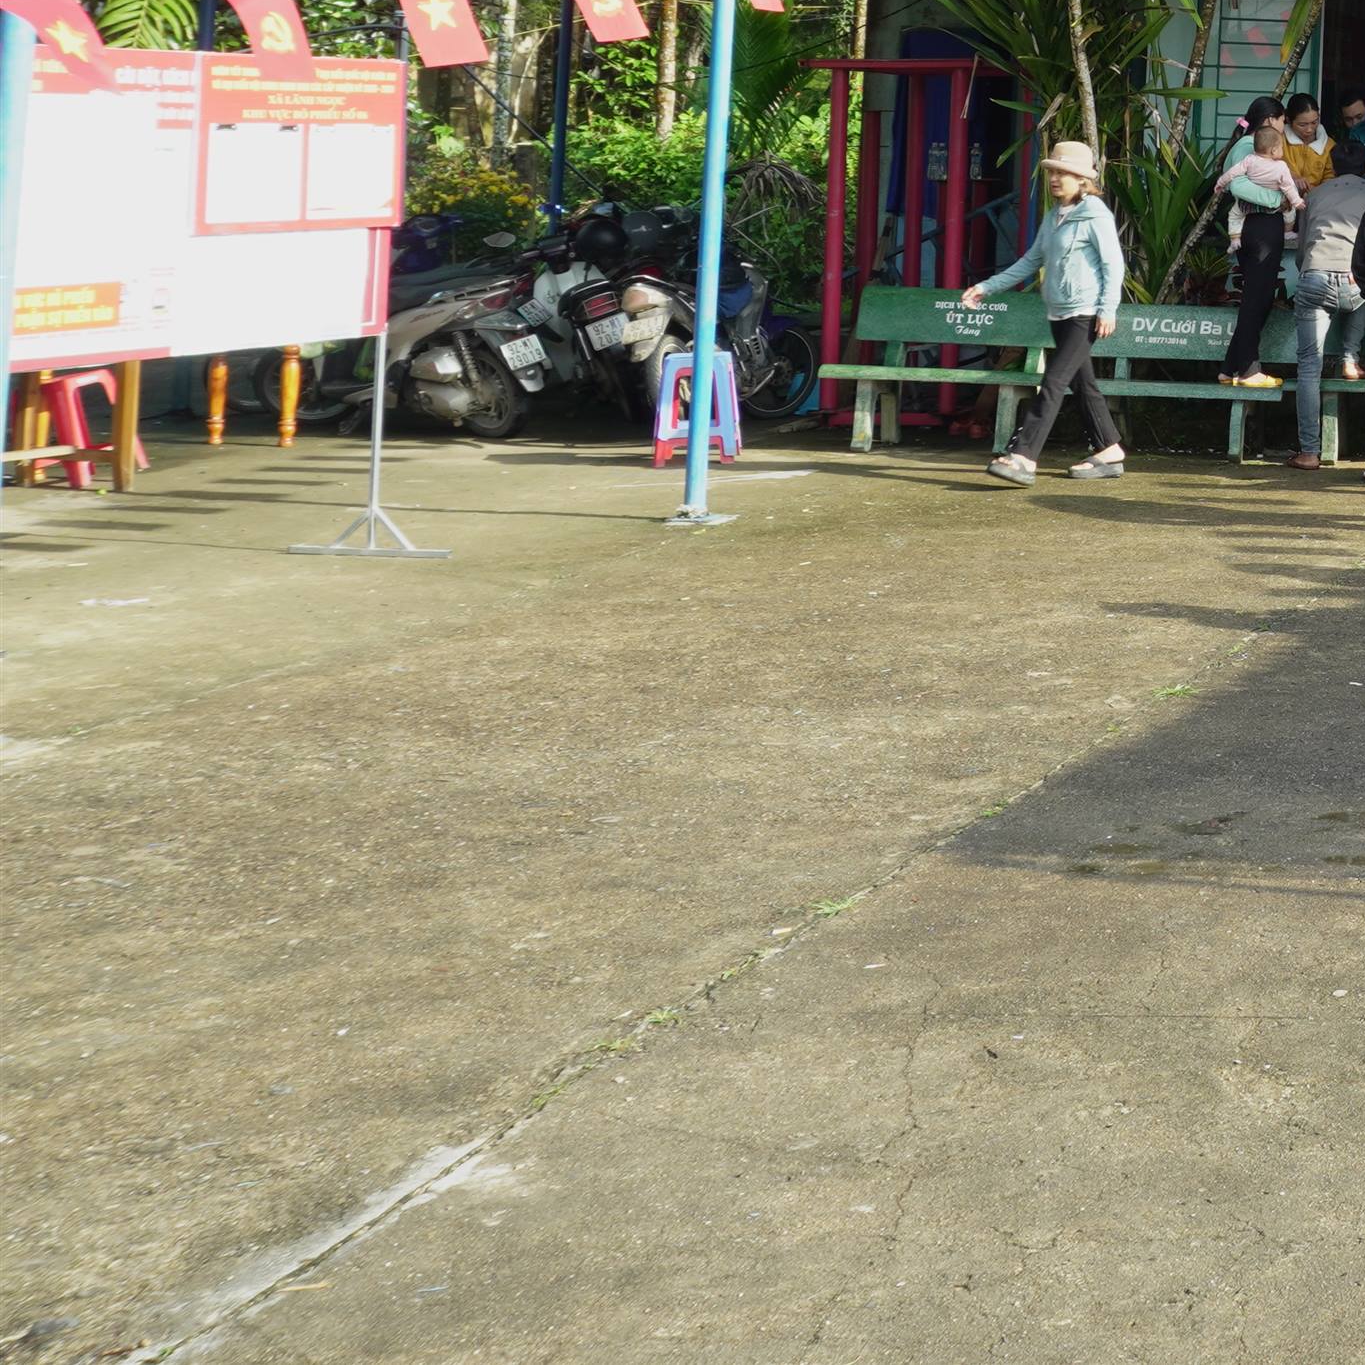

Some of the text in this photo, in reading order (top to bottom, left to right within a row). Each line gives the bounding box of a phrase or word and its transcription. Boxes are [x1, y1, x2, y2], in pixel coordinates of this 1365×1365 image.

[935, 301, 955, 309] DỊCH
[946, 310, 994, 326] ÚT LỰC
[1132, 317, 1159, 332] DV
[1160, 319, 1197, 334] Cưới
[1200, 320, 1222, 335] Ba
